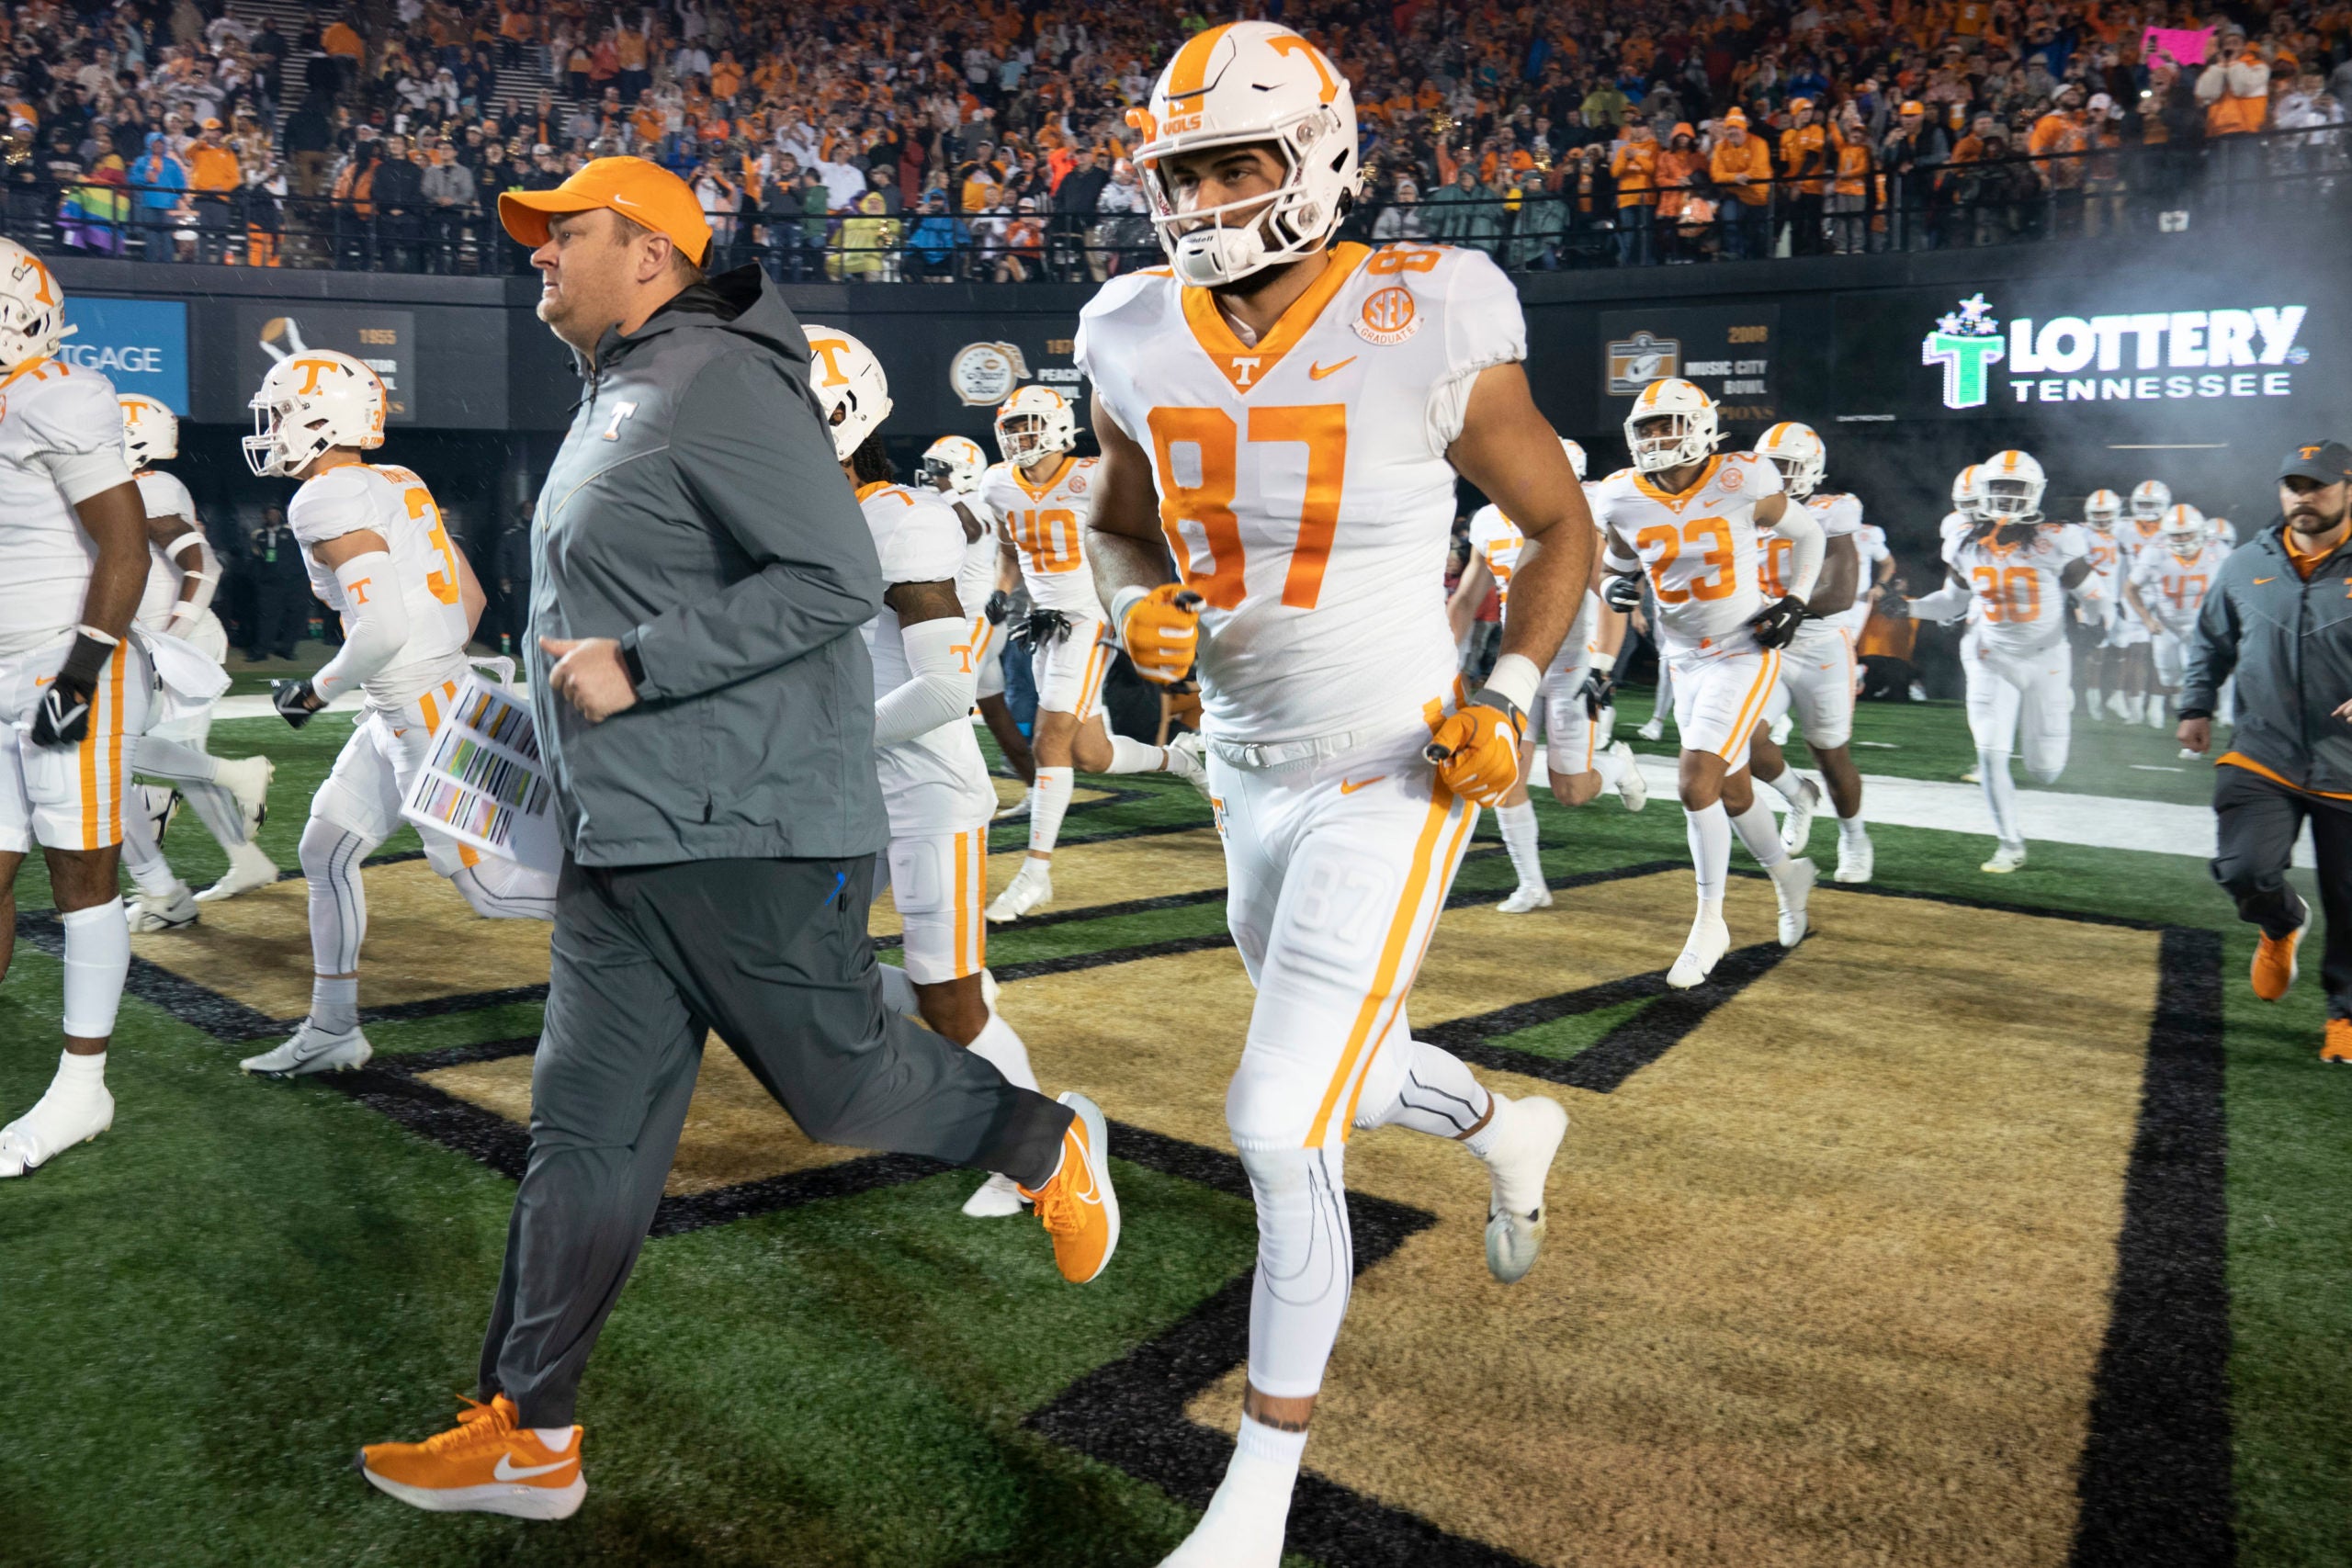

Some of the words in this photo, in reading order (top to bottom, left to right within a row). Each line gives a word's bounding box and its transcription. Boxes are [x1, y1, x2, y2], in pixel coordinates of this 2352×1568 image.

[1163, 115, 1202, 136] VOLS
[23, 255, 55, 308] T
[1369, 288, 1410, 329] SEC
[1360, 325, 1416, 344] GRADUATE
[2009, 306, 2307, 373] LOTTERY
[59, 344, 163, 372] TGAGE
[808, 339, 851, 387] T
[1231, 357, 1261, 385] T
[1684, 361, 1733, 376] MUSIC
[1735, 360, 1768, 374] CITY
[292, 359, 338, 396] T
[1037, 369, 1082, 382] PEACH
[1724, 379, 1768, 395] BOWL
[2010, 372, 2291, 402] TENNESSEE
[119, 401, 149, 426] T
[602, 400, 640, 442] T
[2299, 446, 2321, 460] T
[1147, 403, 1347, 612] 87
[1007, 509, 1082, 573] 40
[1636, 516, 1736, 604] 23
[347, 577, 372, 605] T
[1973, 566, 2040, 623] 30
[2163, 574, 2208, 610] 47
[949, 645, 972, 673] T
[1293, 856, 1388, 948] 87
